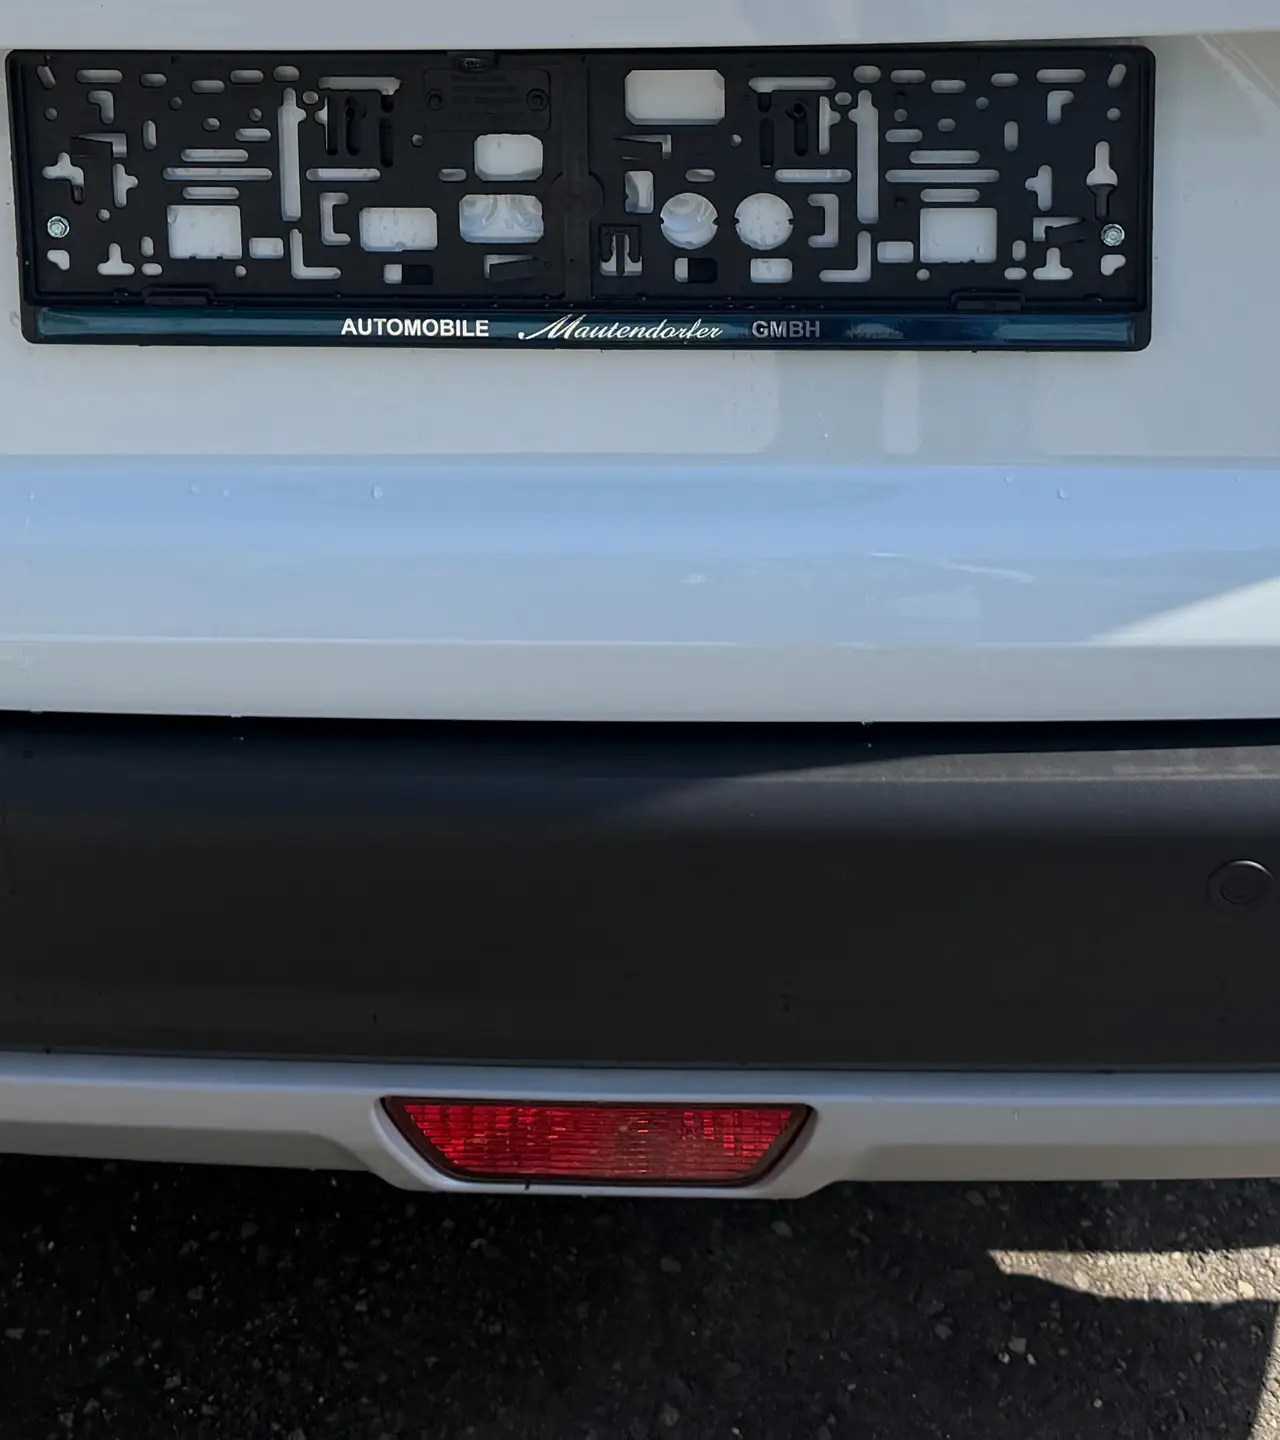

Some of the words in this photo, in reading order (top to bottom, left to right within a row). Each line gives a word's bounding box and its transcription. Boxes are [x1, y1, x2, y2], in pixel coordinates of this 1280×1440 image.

[340, 317, 490, 338] AUTOMOBILE
[517, 313, 724, 345] Mautendorfer
[751, 319, 821, 339] GMBH
